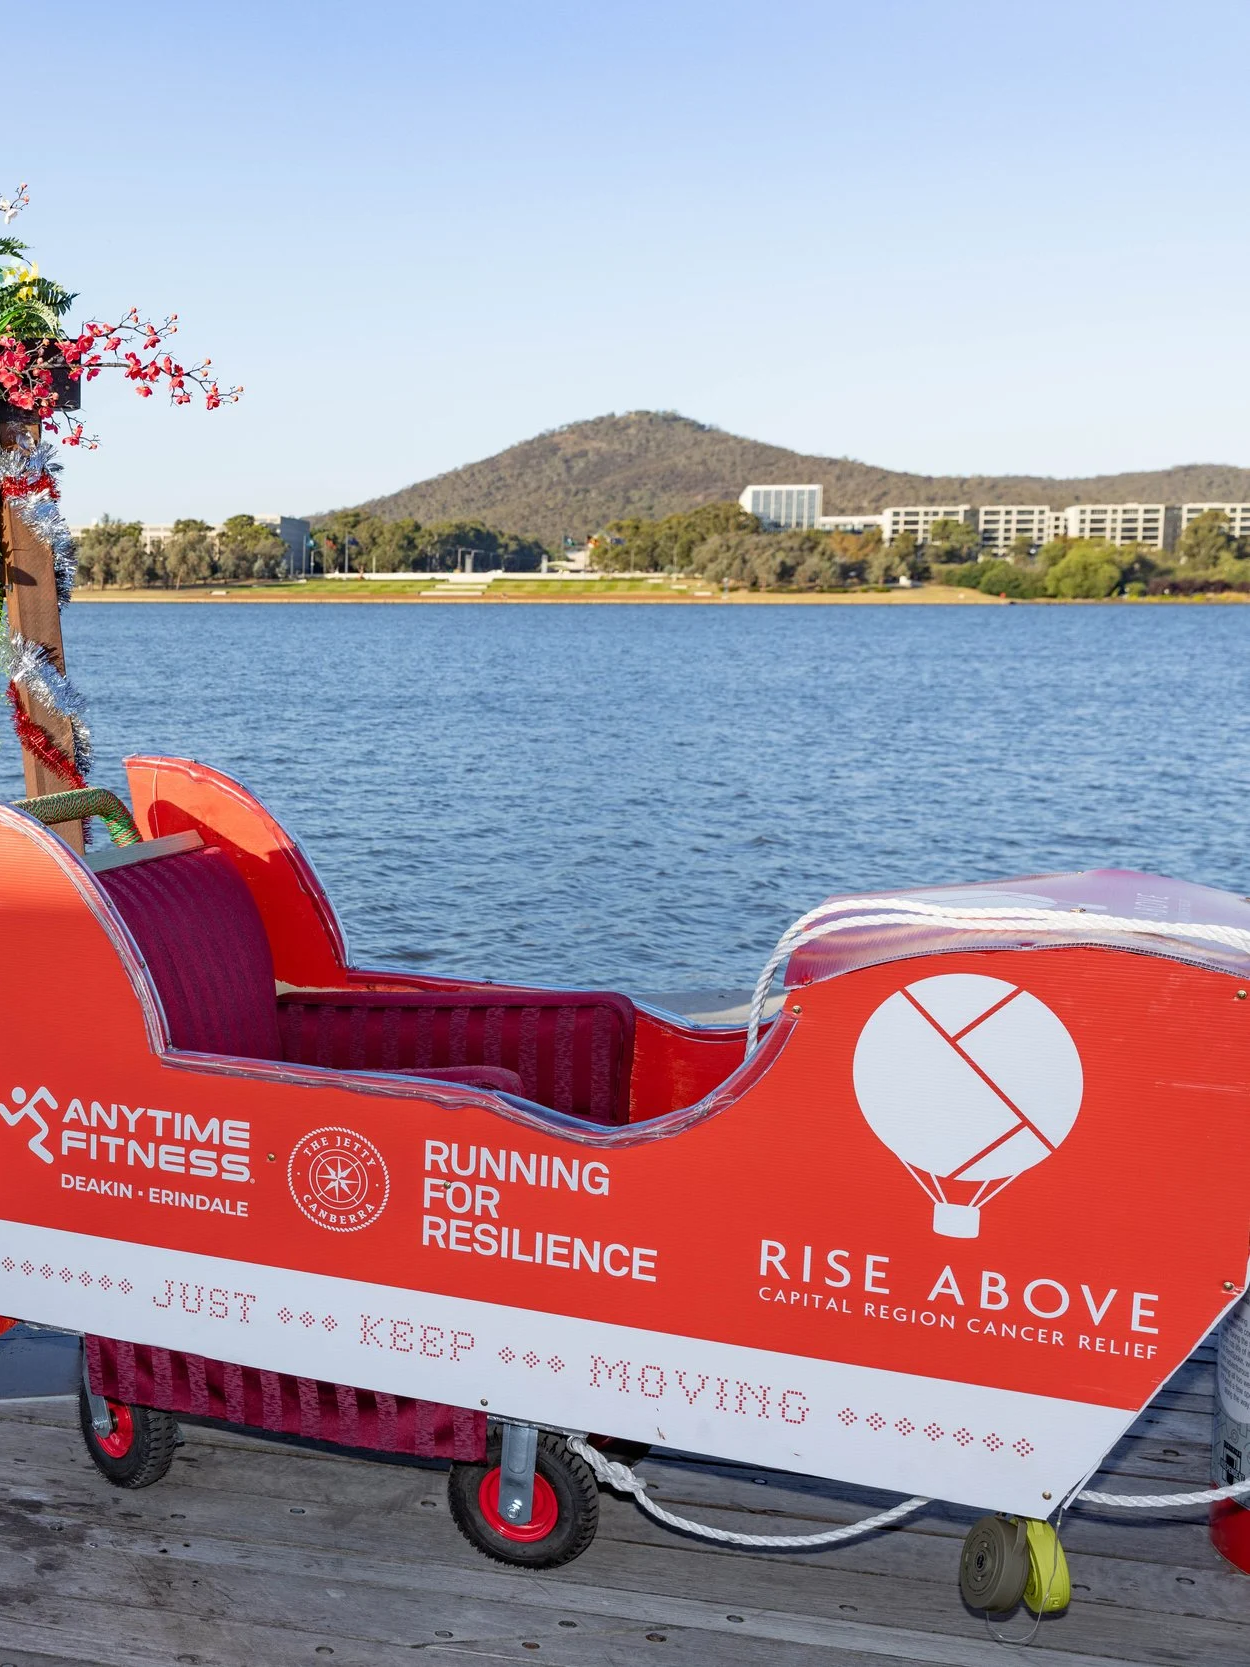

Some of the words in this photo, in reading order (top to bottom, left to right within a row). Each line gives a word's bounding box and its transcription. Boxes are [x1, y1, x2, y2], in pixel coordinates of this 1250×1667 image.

[63, 1099, 249, 1148] ANYTIME
[62, 1130, 250, 1183] FITNESS
[303, 1137, 329, 1156] THE
[336, 1136, 376, 1166] JETTY
[425, 1140, 609, 1195] RUNNING
[62, 1174, 132, 1198] DEAKIN
[150, 1188, 248, 1217] ERINDALE
[303, 1194, 375, 1224] CANBERRA
[424, 1178, 500, 1218] FOR
[423, 1215, 657, 1282] RESILIENCE
[760, 1240, 889, 1294] RISE
[927, 1265, 1158, 1334] ABOVE
[759, 1287, 851, 1313] CAPITAL
[865, 1303, 954, 1329] REGION
[967, 1319, 1064, 1346] CANCER
[1079, 1335, 1157, 1359] RELIEF
[152, 1279, 256, 1324] JUST
[359, 1314, 475, 1361] KEEP
[589, 1354, 810, 1425] MOVING
